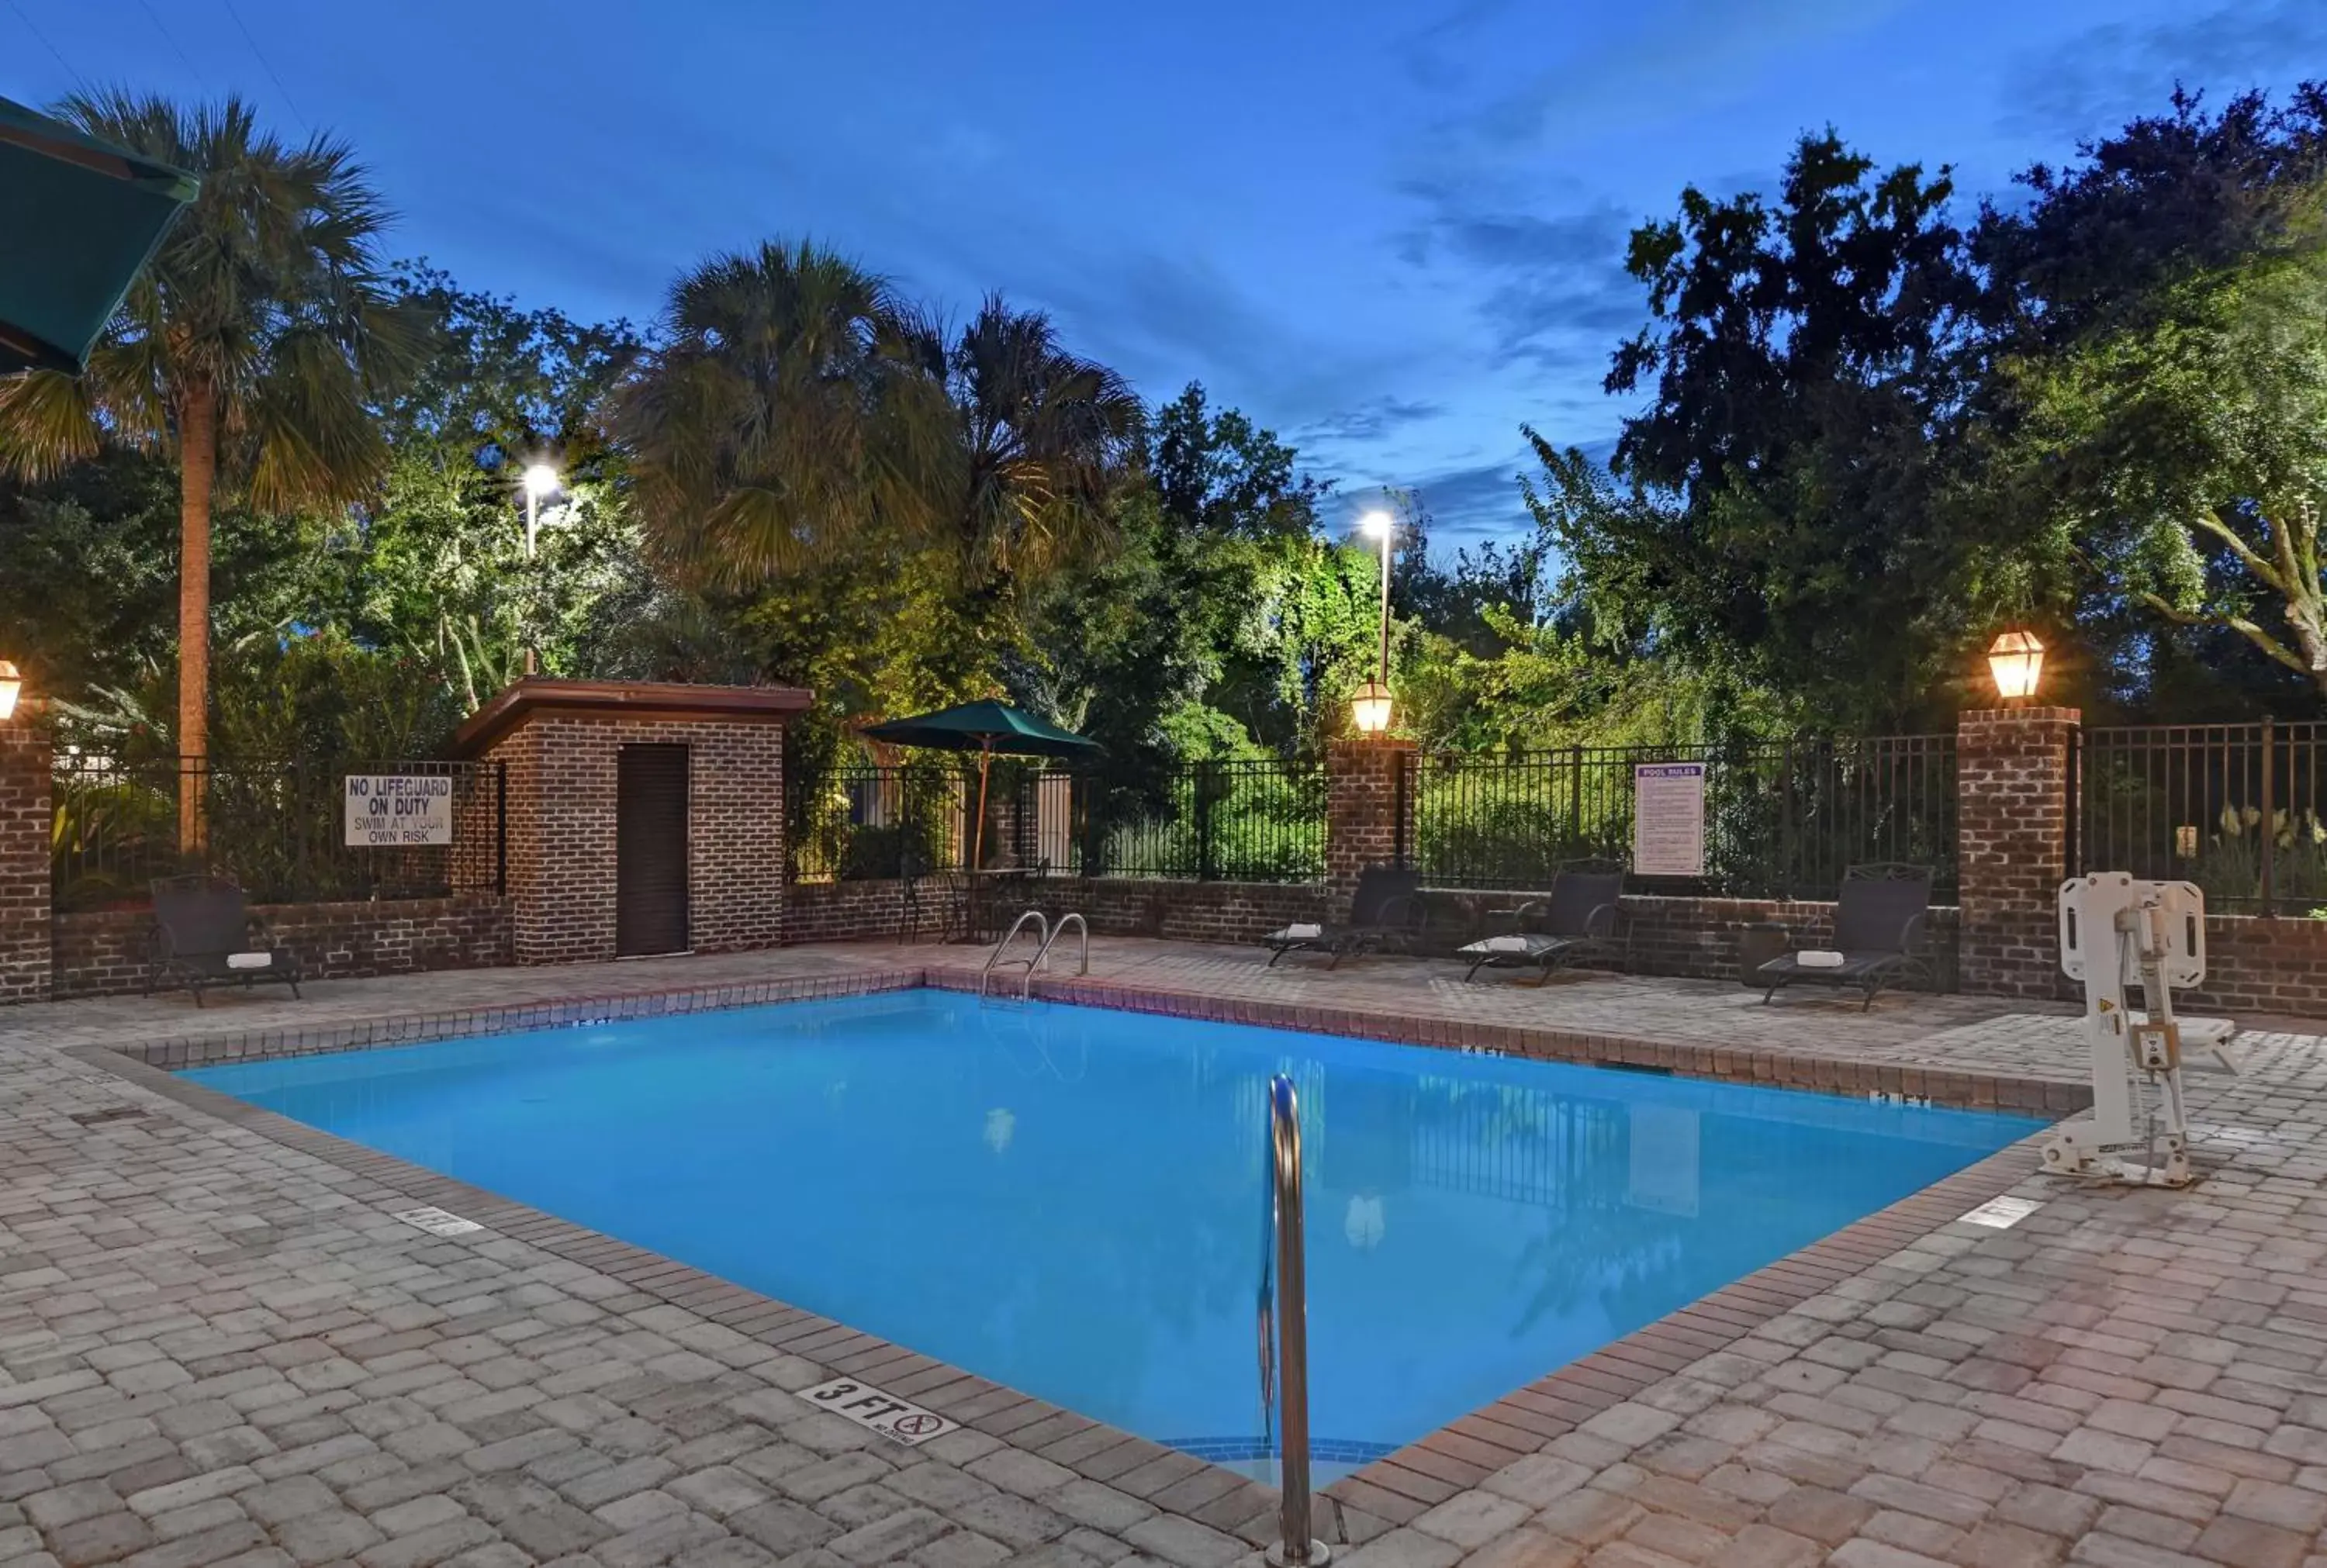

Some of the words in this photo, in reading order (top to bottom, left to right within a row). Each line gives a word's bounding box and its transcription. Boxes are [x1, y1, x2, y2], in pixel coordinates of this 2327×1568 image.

[350, 779, 368, 796] NO
[376, 779, 448, 796] LIFEGUARD
[369, 797, 388, 815] ON
[395, 798, 429, 815] DUTY
[354, 817, 385, 830] SWIM
[391, 817, 406, 829] AT
[368, 831, 396, 843] OWN
[403, 830, 429, 842] RISK
[814, 1384, 859, 1400] 3
[840, 1396, 910, 1420] FT
